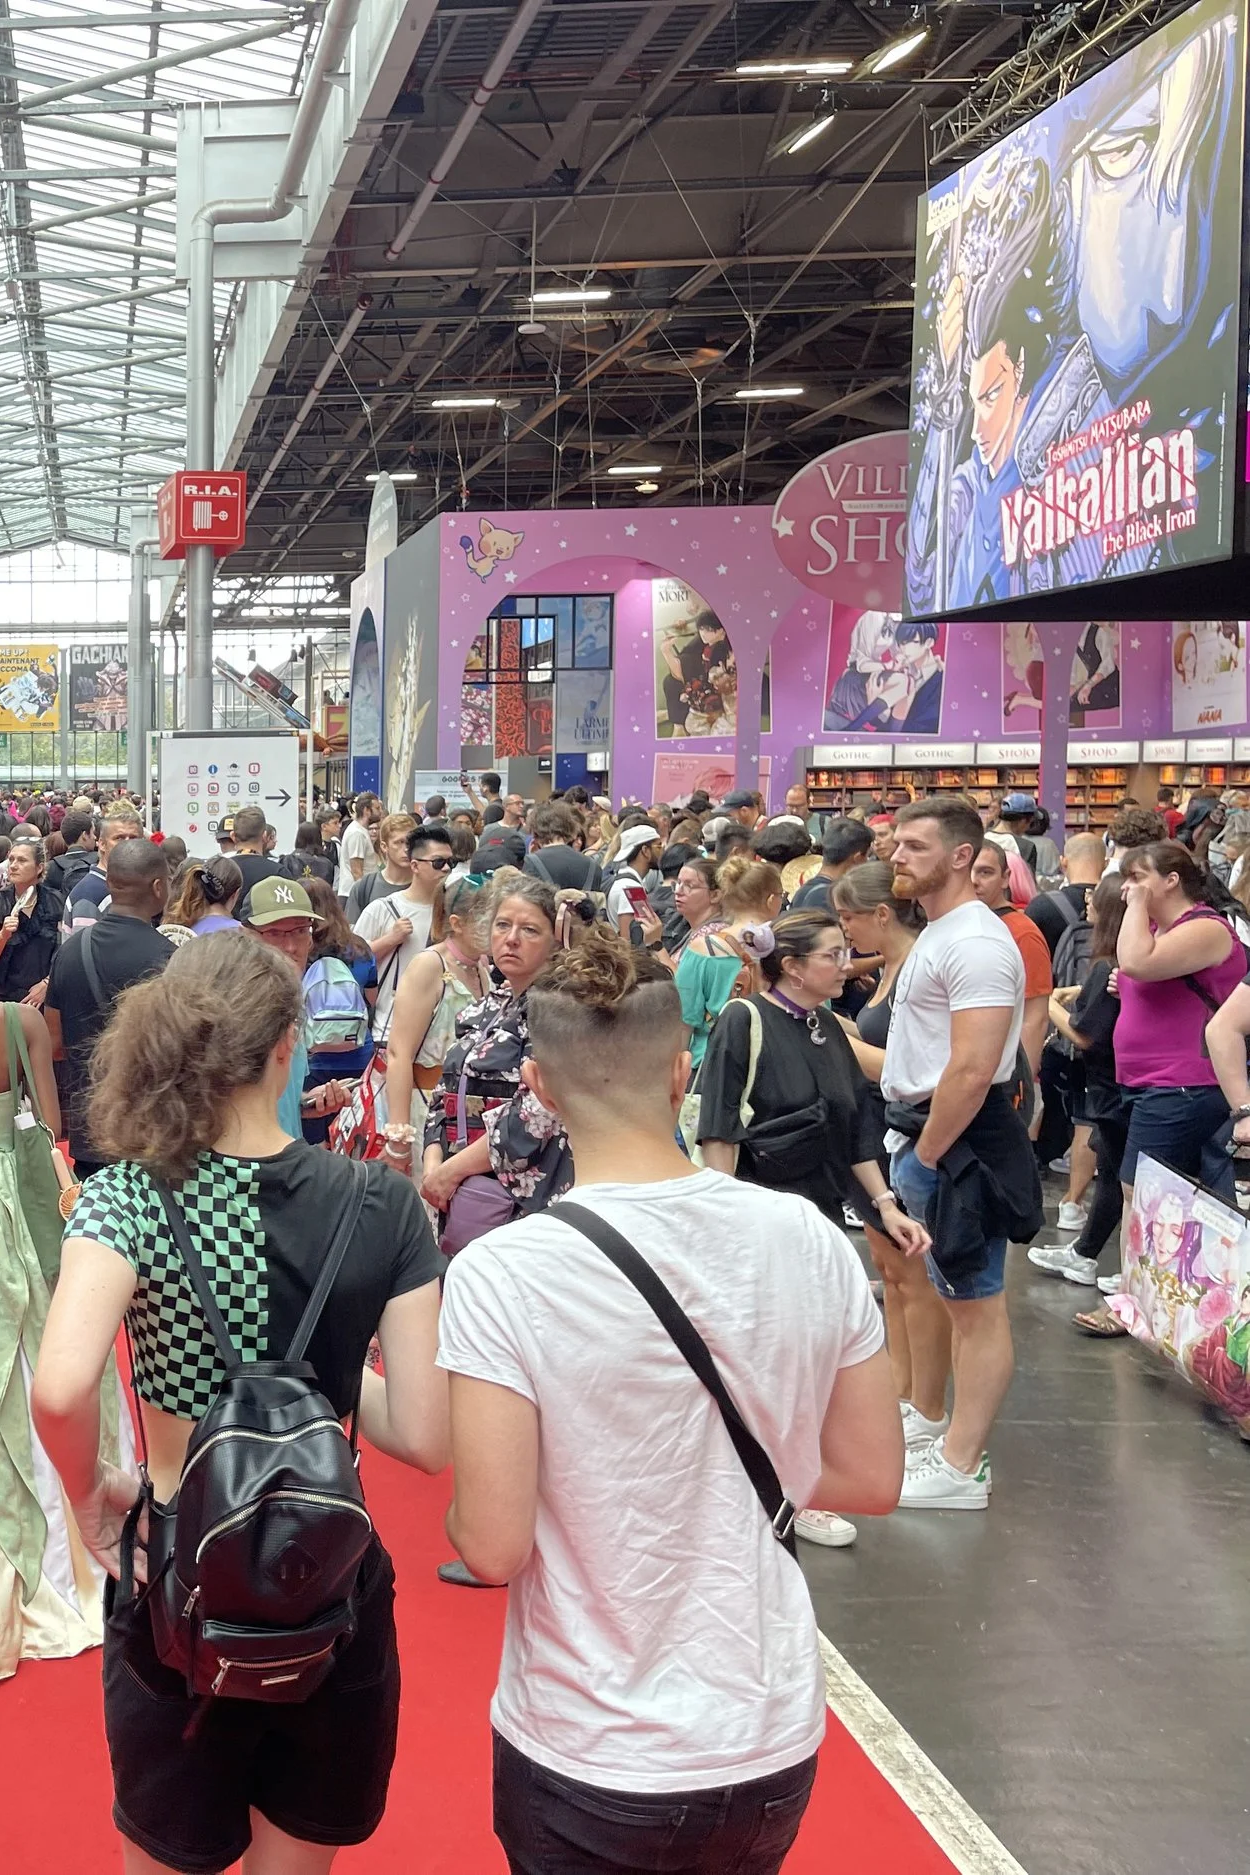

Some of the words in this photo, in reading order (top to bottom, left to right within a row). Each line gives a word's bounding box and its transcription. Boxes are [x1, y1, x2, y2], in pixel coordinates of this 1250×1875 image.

[1090, 399, 1151, 445] MATSUBARA
[184, 485, 238, 496] R.I.A.
[1001, 428, 1197, 566] Valhallian
[1103, 530, 1122, 556] the
[1126, 514, 1162, 547] Black
[1166, 508, 1196, 534] Iron
[1197, 709, 1222, 725] NANA
[833, 750, 871, 760] GOTHIC
[914, 749, 954, 758] GOTHIC
[274, 885, 295, 904] NY
